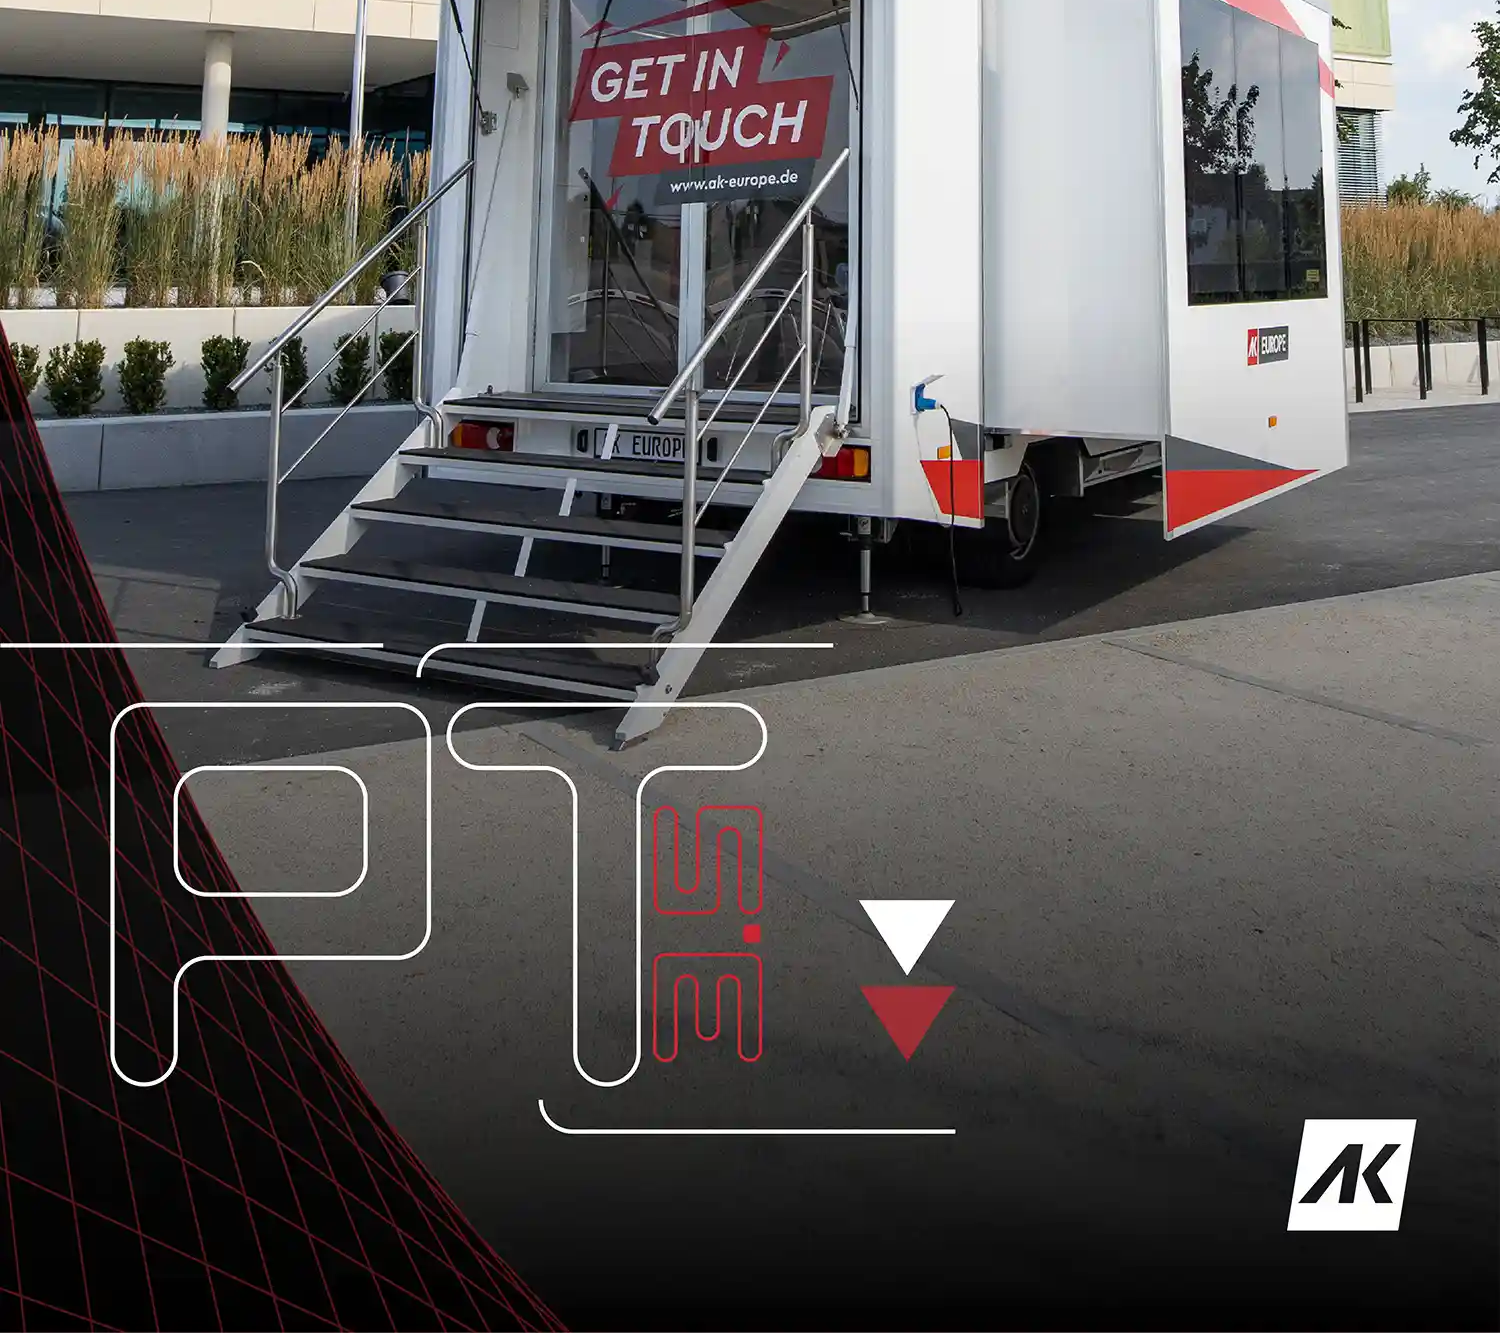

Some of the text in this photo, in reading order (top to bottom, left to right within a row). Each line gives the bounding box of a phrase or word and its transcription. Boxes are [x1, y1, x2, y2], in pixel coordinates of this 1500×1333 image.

[590, 46, 744, 103] GET IN
[631, 100, 808, 158] TOUCH
[670, 169, 799, 194] www.ak-europe.de
[1261, 333, 1287, 355] EUROPE
[632, 434, 686, 459] EUROP
